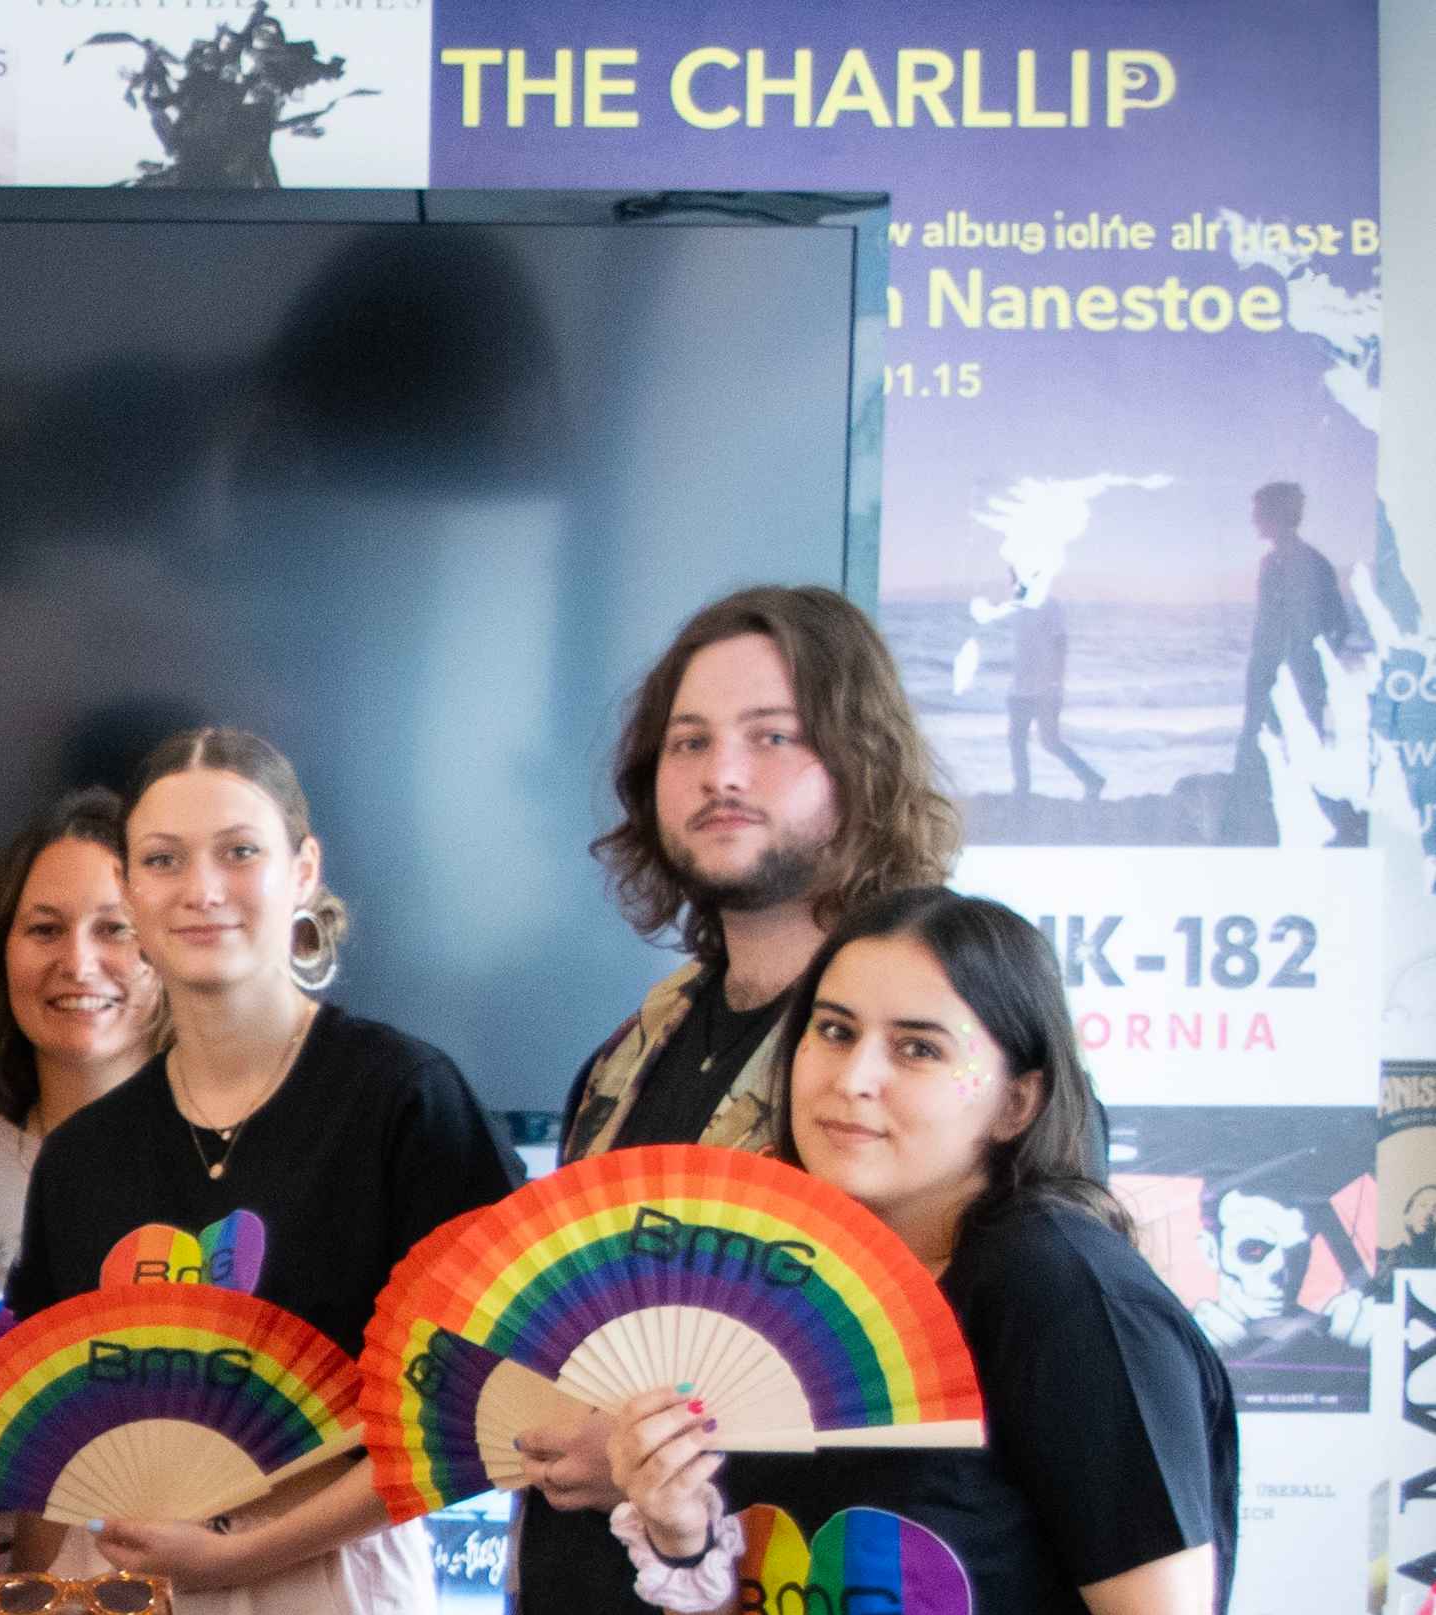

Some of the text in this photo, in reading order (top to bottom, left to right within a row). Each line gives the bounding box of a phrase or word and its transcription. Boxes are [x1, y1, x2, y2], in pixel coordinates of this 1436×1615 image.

[441, 50, 638, 128] THE
[629, 1207, 818, 1291] BMG
[89, 1338, 255, 1393] BMG
